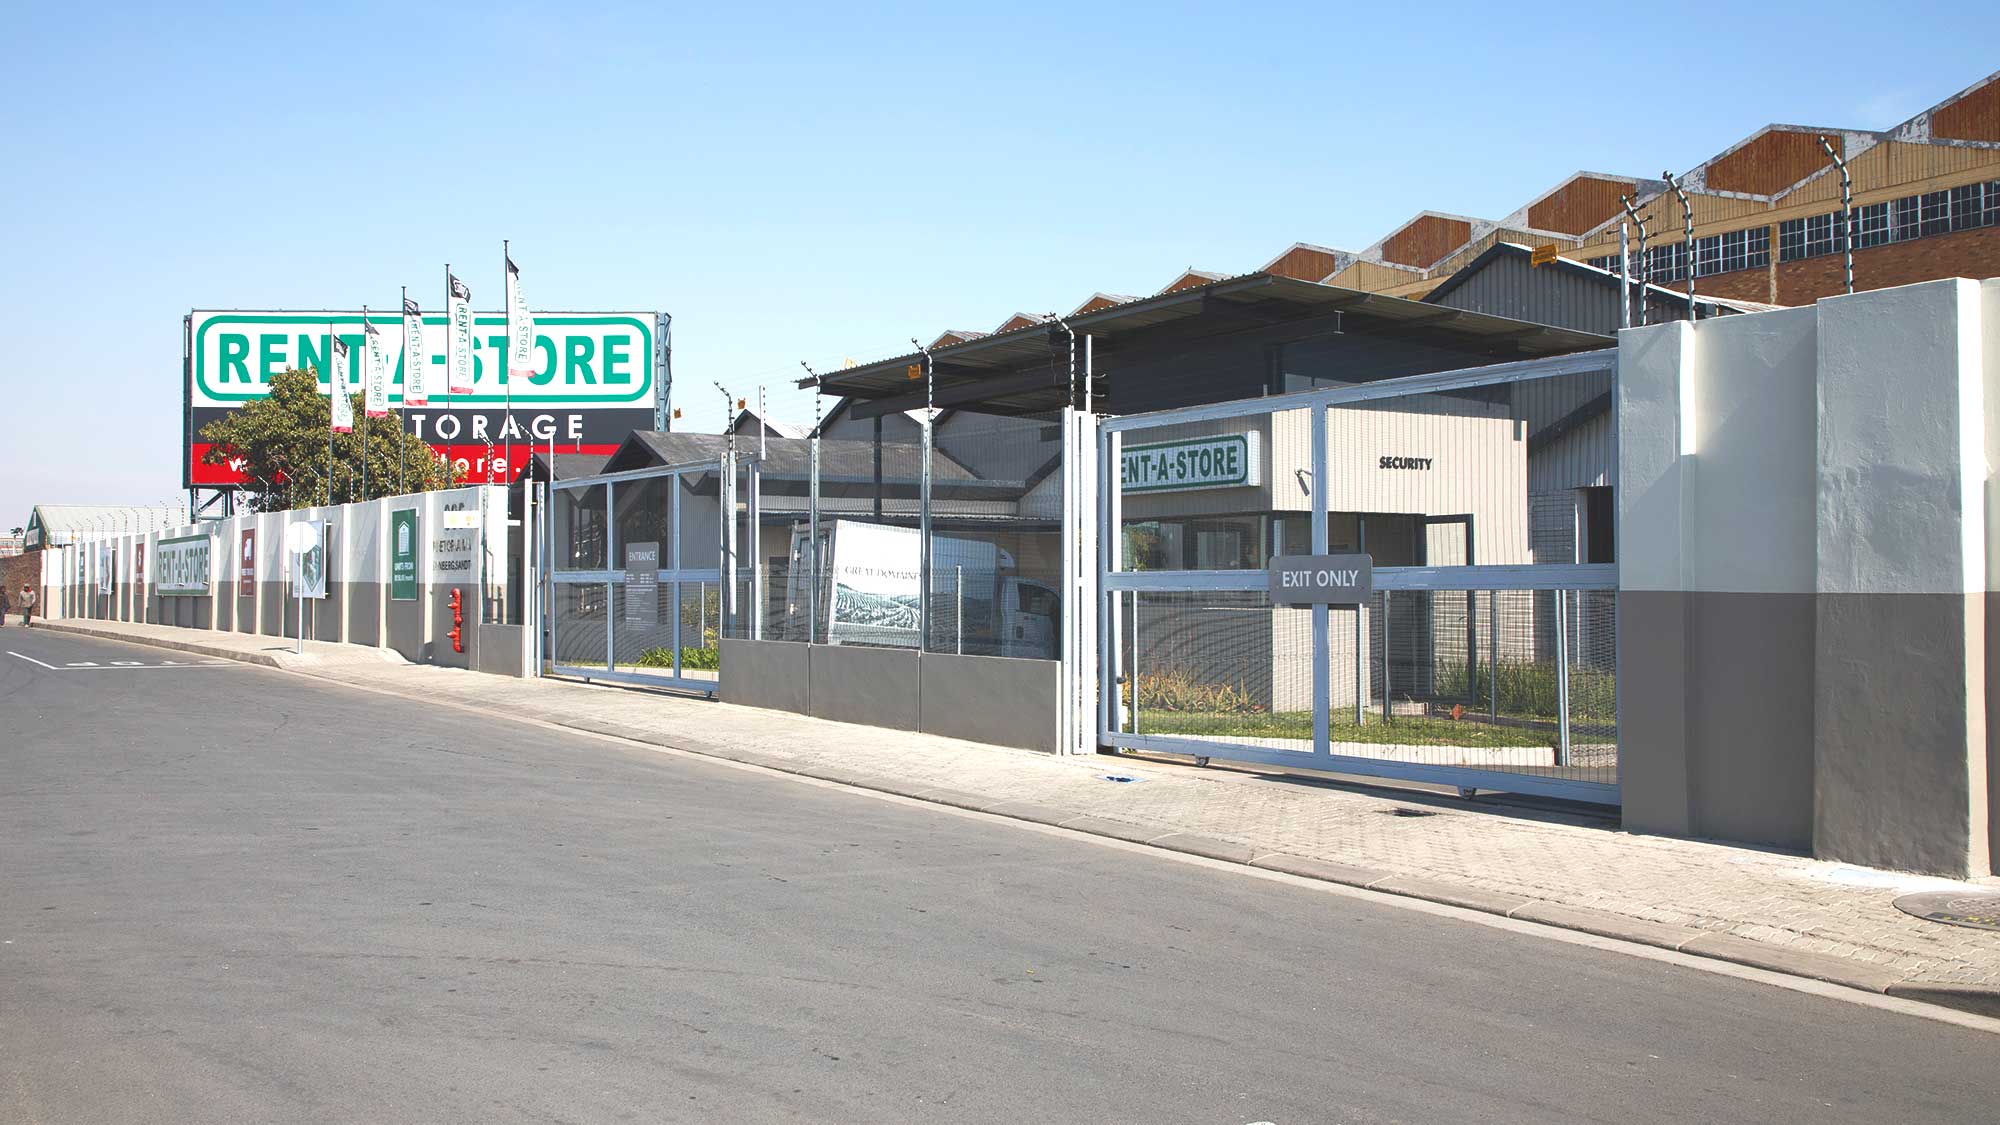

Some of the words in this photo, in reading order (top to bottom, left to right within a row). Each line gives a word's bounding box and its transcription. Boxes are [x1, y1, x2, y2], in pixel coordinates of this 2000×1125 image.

[411, 414, 584, 440] TORAGE
[1121, 445, 1238, 484] ENT-A-STORE
[1379, 456, 1433, 471] SECURITY
[628, 550, 656, 561] ENTRANCE
[1282, 571, 1312, 587] EXIT
[1316, 570, 1359, 587] ONLY
